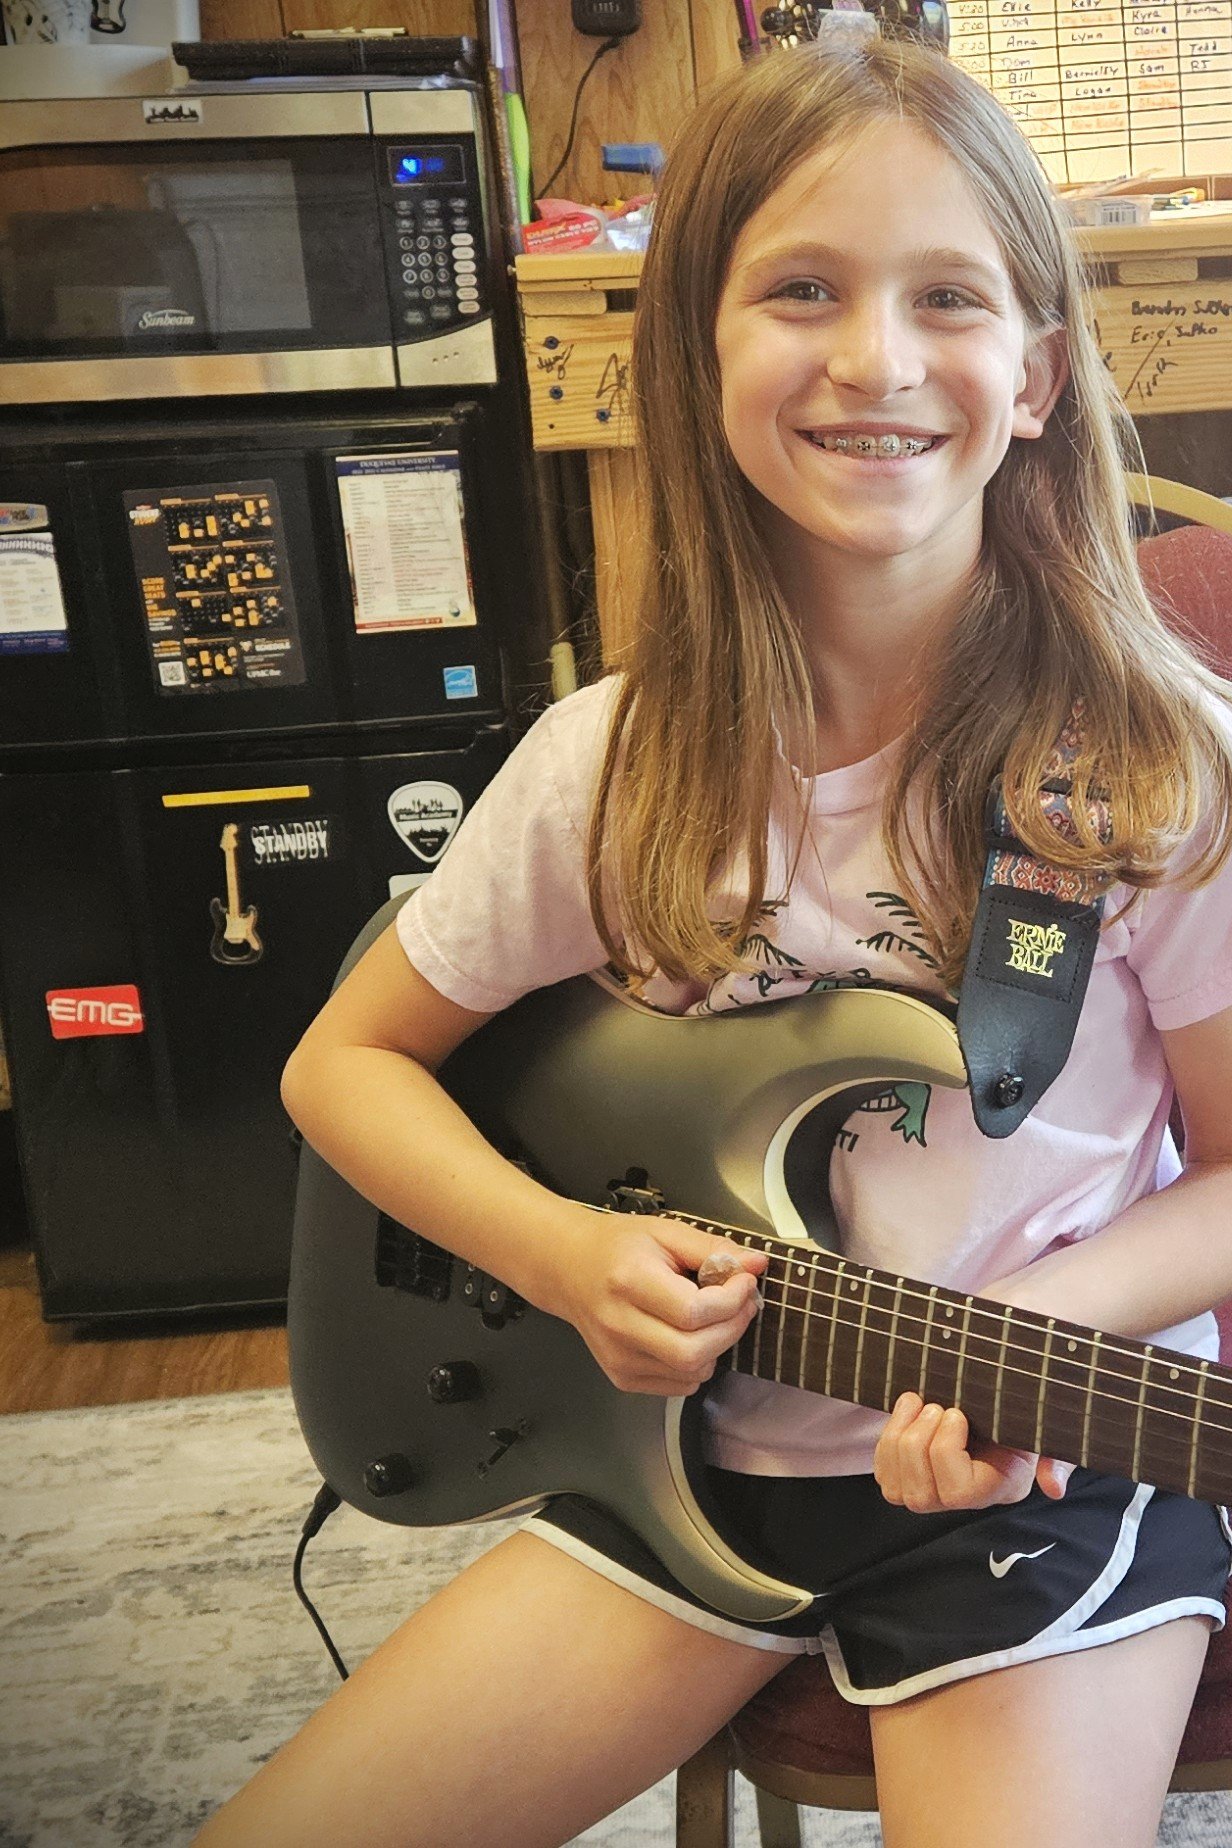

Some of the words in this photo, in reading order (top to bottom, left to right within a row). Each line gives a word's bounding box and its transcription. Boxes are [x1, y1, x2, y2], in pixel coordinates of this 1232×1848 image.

[139, 309, 195, 329] Sunbeam
[1006, 918, 1066, 955] ERNIE
[1005, 945, 1054, 977] BALL
[48, 997, 142, 1027] EMG
